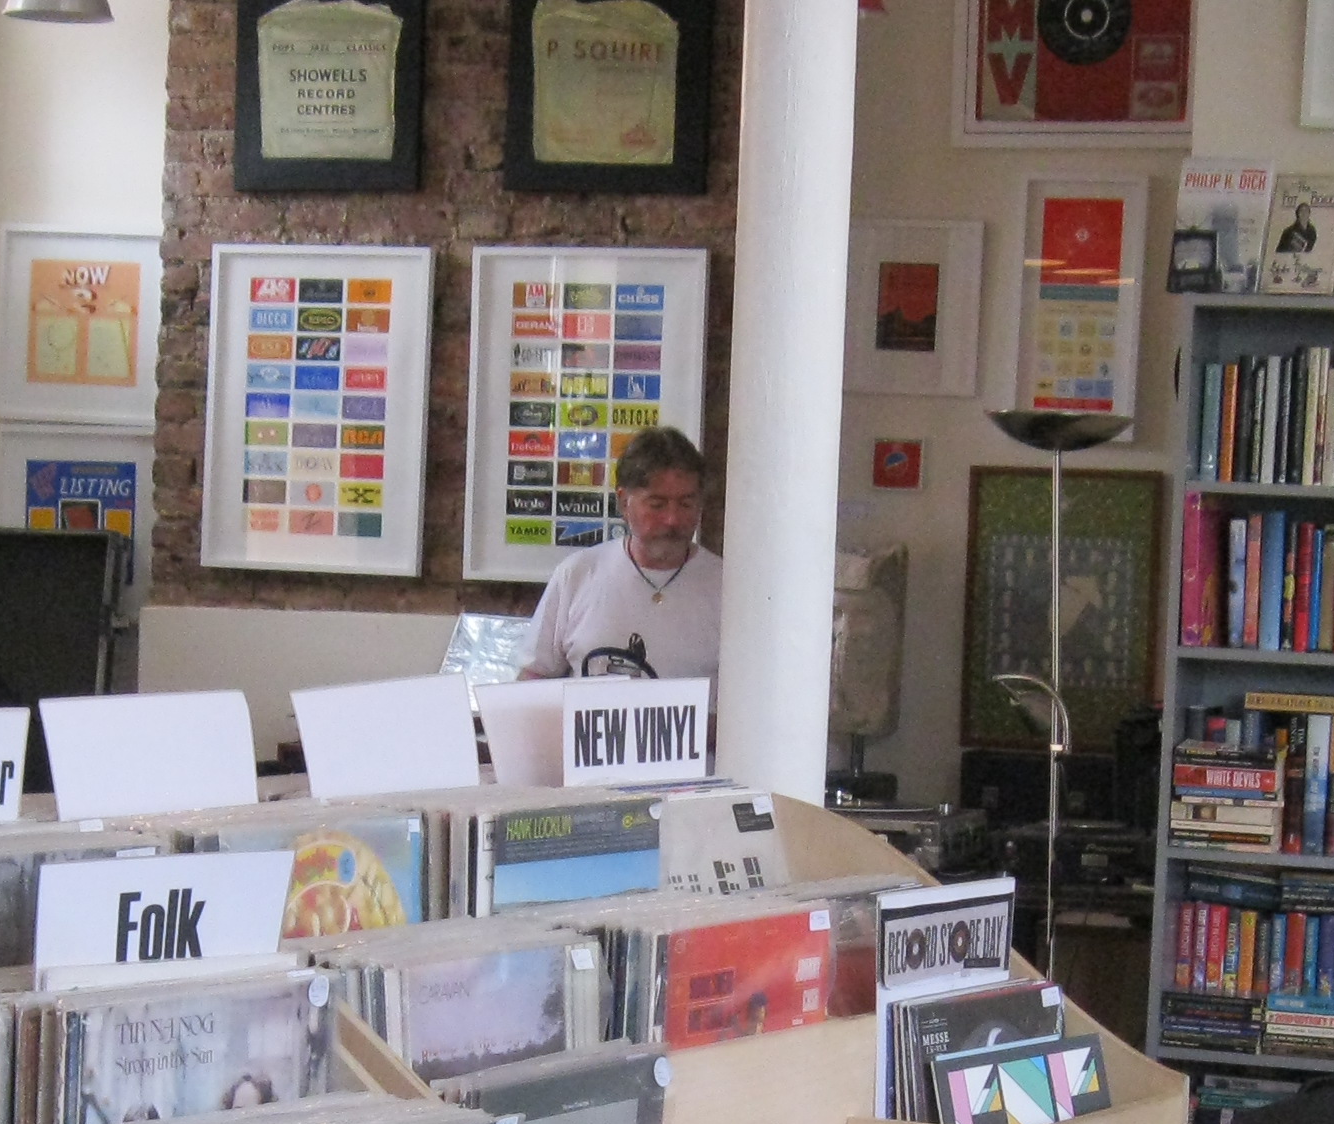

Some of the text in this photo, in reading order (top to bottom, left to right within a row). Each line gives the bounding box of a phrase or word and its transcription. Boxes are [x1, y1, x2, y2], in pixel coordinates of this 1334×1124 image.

[289, 68, 367, 82] SHOWELLS
[297, 88, 356, 99] RECORD
[296, 104, 356, 116] CENTRES
[1185, 172, 1220, 189] PHILIP
[1239, 175, 1267, 191] DICK
[61, 265, 111, 286] NOW
[617, 294, 660, 304] CHESS
[256, 309, 288, 325] DECCA
[612, 408, 659, 426] ORIOLE
[59, 478, 133, 497] LISTING
[559, 500, 600, 514] wand
[510, 526, 548, 535] YAMBO
[573, 703, 700, 770] NEW VINYL
[1205, 769, 1262, 789] WHITE DEVILS
[116, 887, 206, 964] Folk
[887, 915, 1005, 976] RECORD STORE DAY
[115, 1017, 146, 1045] TIR
[176, 1012, 215, 1039] NOG
[922, 1031, 950, 1047] MESSE
[115, 1057, 157, 1077] Strong
[190, 1048, 214, 1065] Sun
